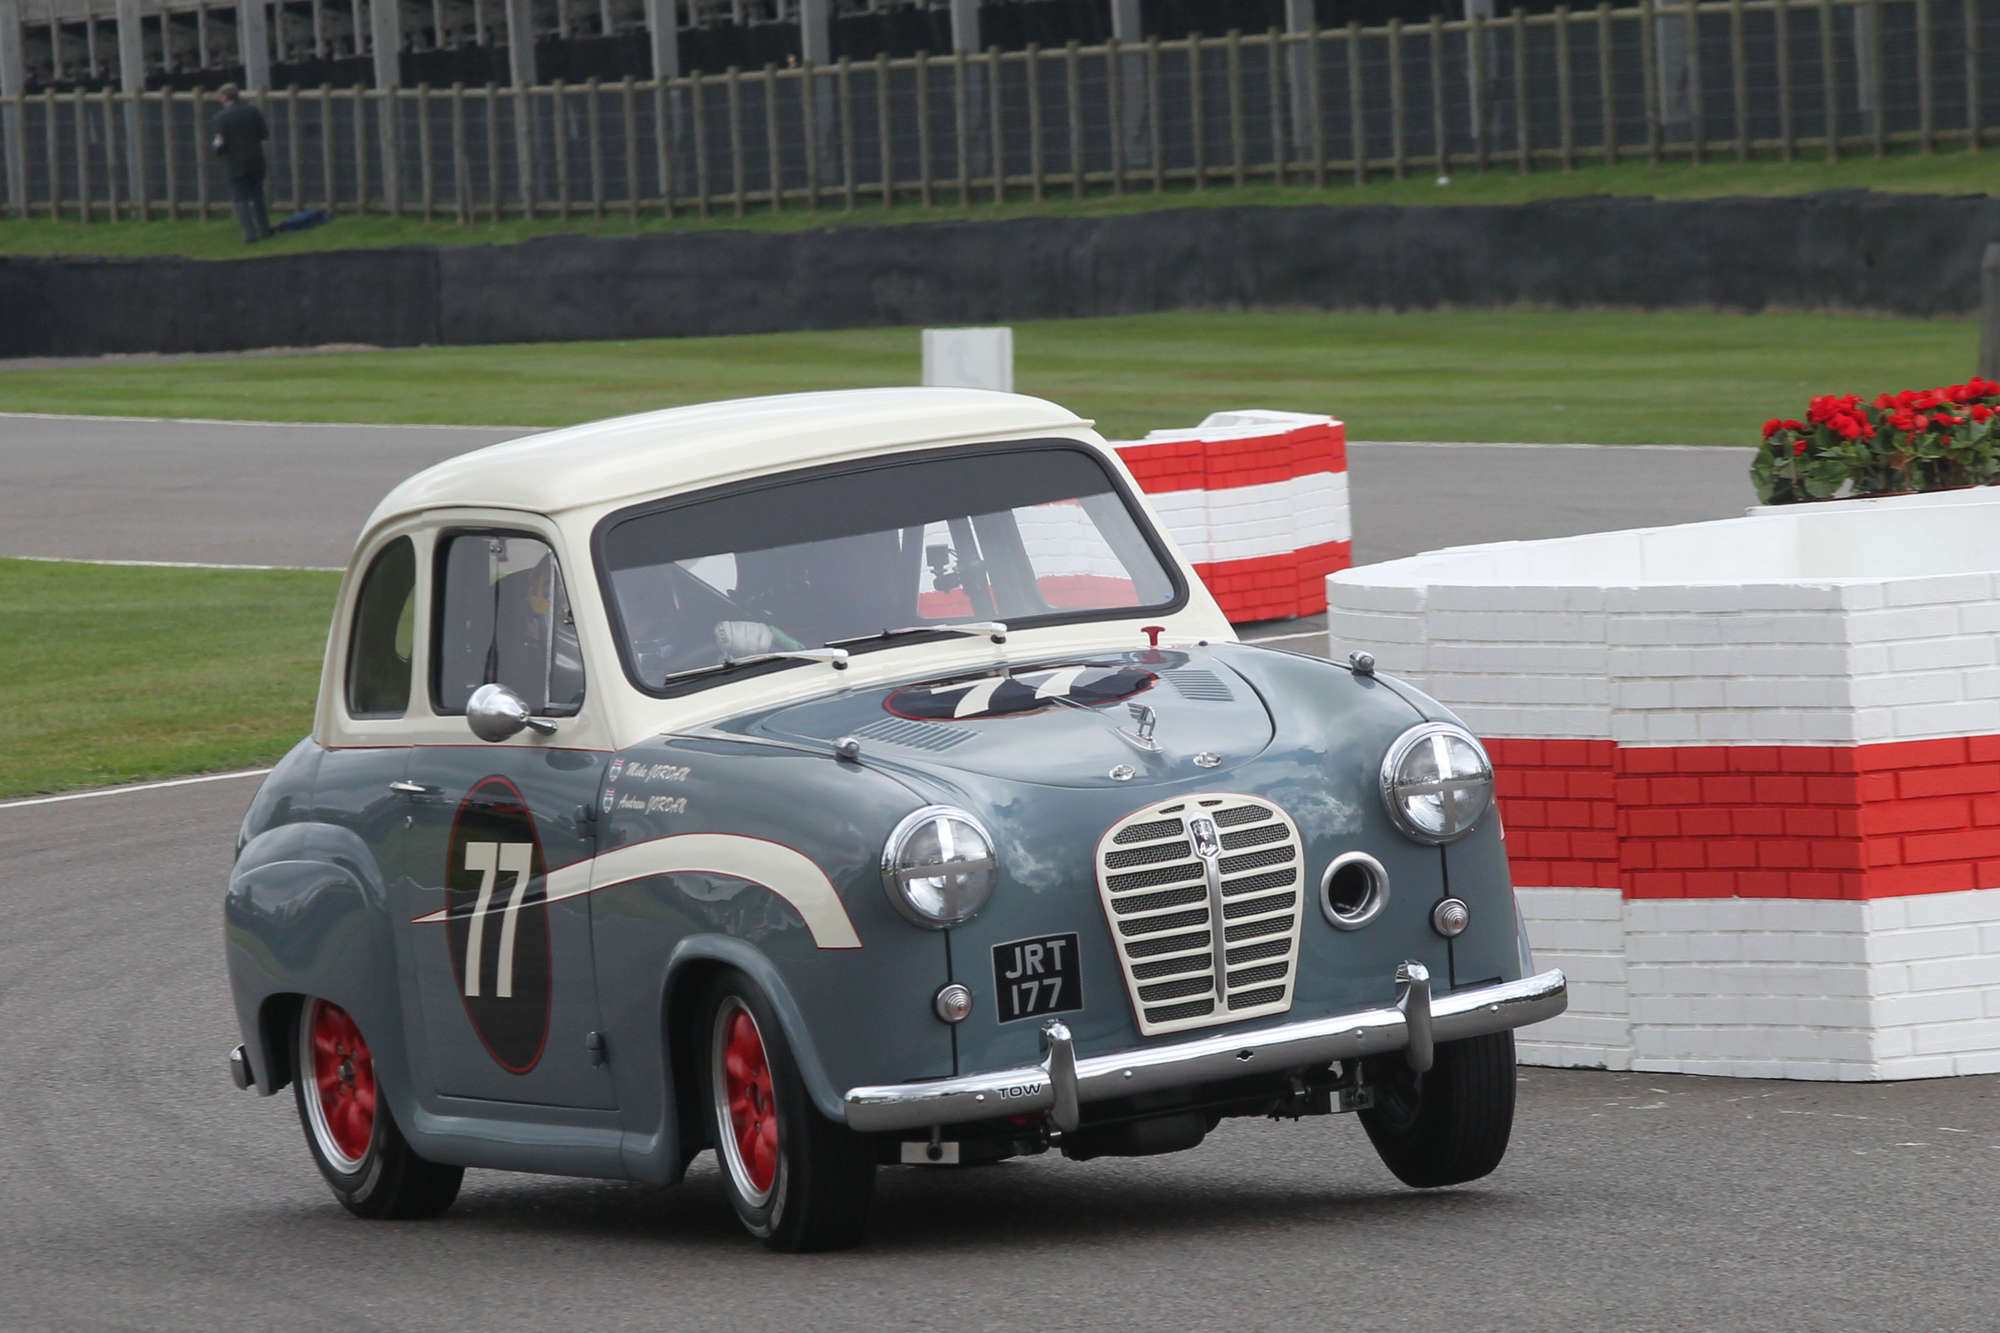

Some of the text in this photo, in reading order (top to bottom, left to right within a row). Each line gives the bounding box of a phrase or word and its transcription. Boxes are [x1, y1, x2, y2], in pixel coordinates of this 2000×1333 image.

[930, 664, 1087, 718] 77
[464, 841, 533, 998] 77
[1005, 940, 1066, 979] JRT
[1011, 976, 1062, 1016] 177
[999, 1083, 1042, 1099] TOW
